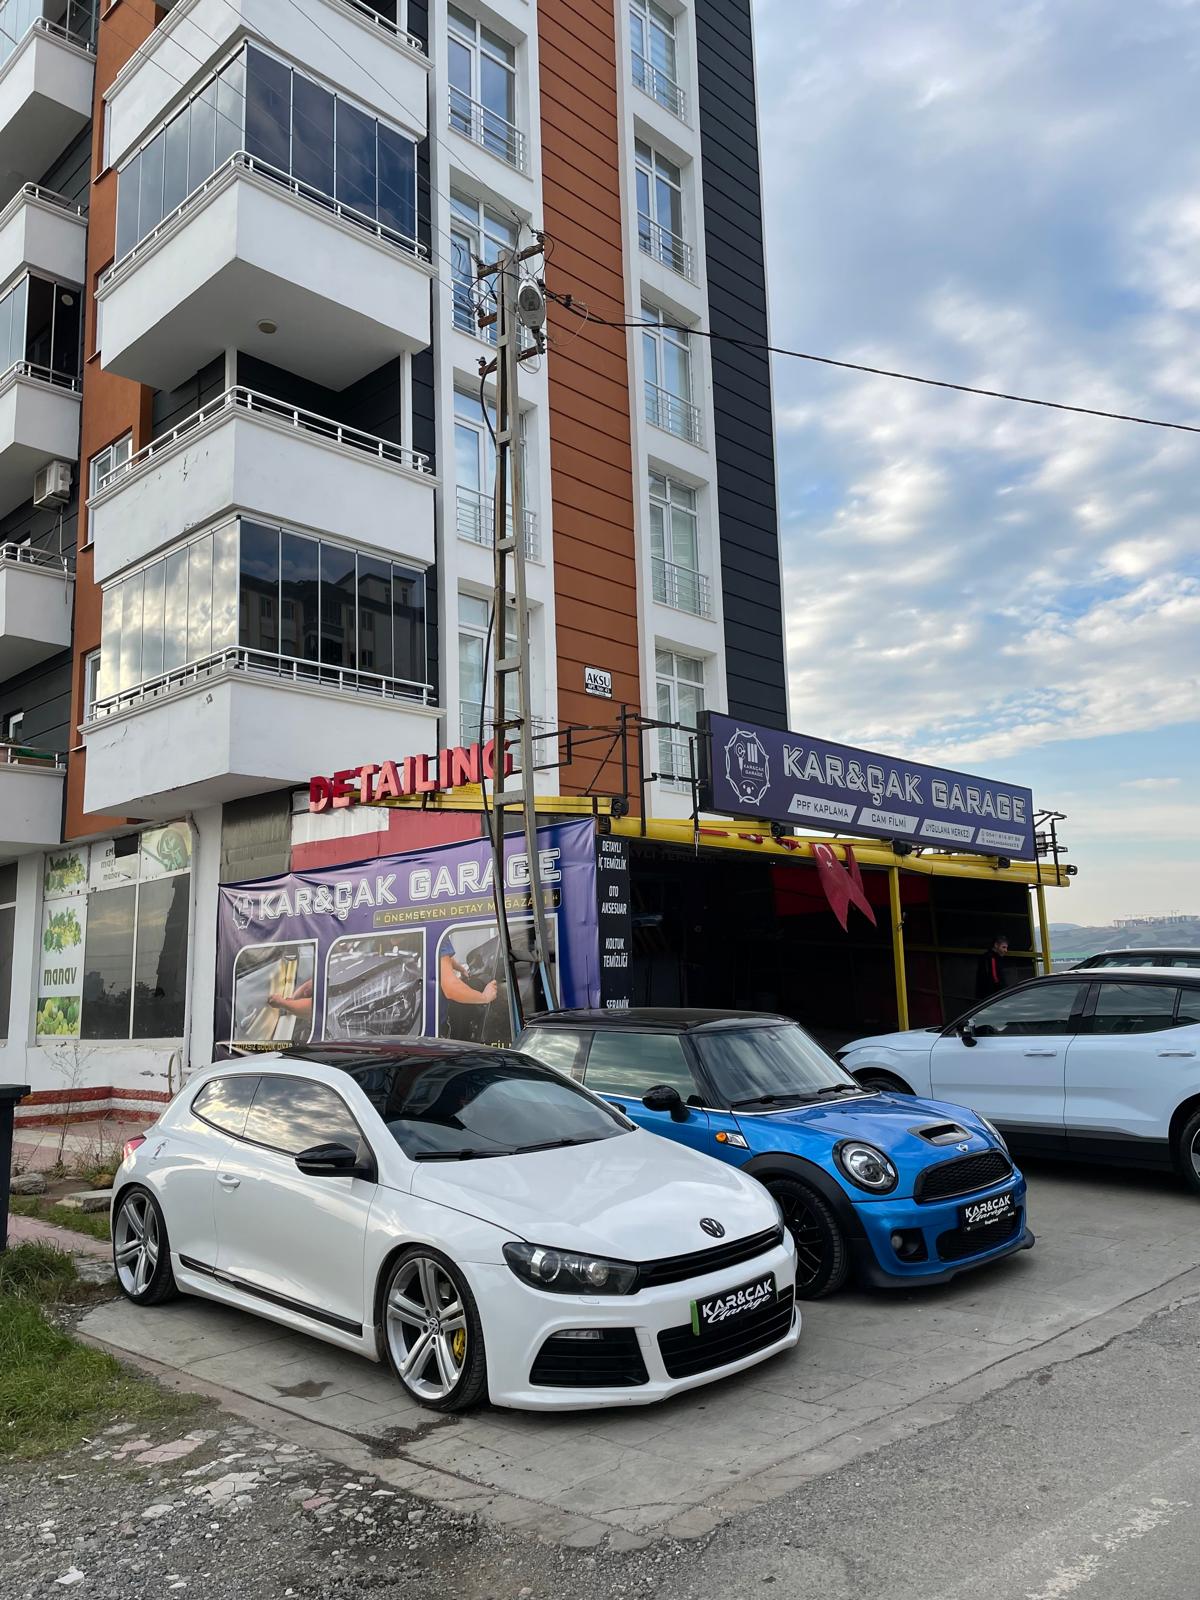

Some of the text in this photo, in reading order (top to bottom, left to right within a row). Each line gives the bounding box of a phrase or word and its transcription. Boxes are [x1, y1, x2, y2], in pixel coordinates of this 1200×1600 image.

[587, 673, 610, 687] AKSU
[310, 739, 513, 813] DETAILING
[783, 744, 1026, 824] KAR&ÇAK GARAGE
[796, 799, 849, 818] PPF KAPLAMA
[871, 813, 887, 825] CAM
[602, 840, 622, 853] DETAYLI
[603, 854, 627, 870] TEMİZLİK
[259, 874, 398, 922] KAR&ÇAK
[608, 885, 619, 897] OTO
[384, 908, 446, 923] ÖNEMSEYEN
[450, 903, 483, 915] DETAY
[488, 897, 548, 912] MĞAZAI
[601, 902, 627, 915] AKSESUAR
[605, 938, 625, 950] KOLTUK
[603, 952, 628, 968] TEMİZLİĞİ
[43, 966, 78, 987] manav
[965, 1195, 1011, 1218] KAR&CAK
[968, 1205, 1009, 1223] Garage
[702, 1278, 773, 1318] KAR&CAK
[707, 1293, 771, 1324] Garage
